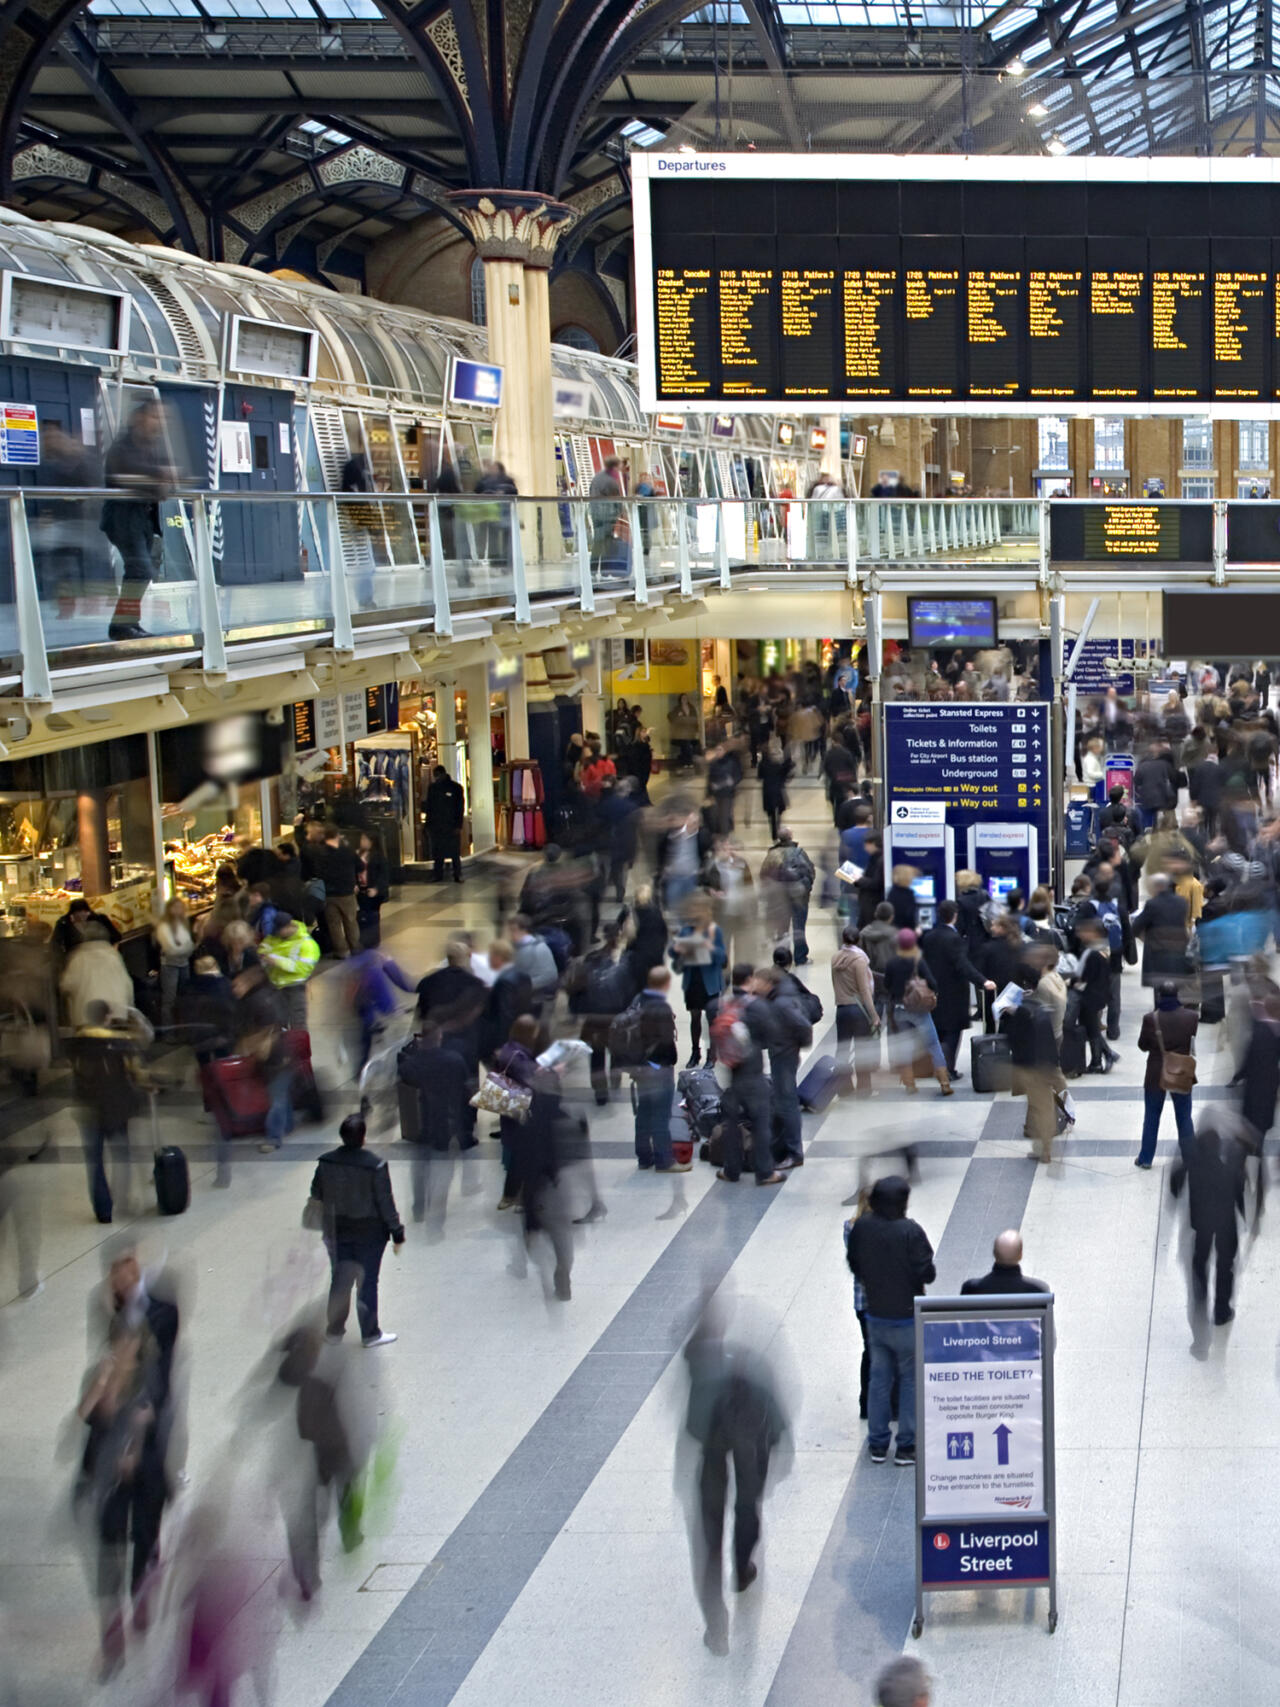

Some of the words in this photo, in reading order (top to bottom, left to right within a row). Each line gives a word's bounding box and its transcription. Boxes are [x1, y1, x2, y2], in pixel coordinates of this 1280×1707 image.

[658, 160, 726, 172] Departures
[684, 270, 710, 278] Cancelled
[866, 271, 890, 279] Platform
[891, 271, 896, 279] 2
[1172, 273, 1197, 281] Platform
[940, 709, 972, 717] Stansted
[975, 709, 1003, 718] Express
[969, 724, 997, 733] Toilets
[906, 739, 937, 748] Tickets
[939, 739, 946, 748] &
[950, 754, 966, 762] Bus
[942, 769, 998, 779] Underground
[960, 784, 980, 793] Way
[960, 799, 980, 808] Way
[943, 1336, 990, 1347] Liverpool
[993, 1335, 1022, 1345] Street
[929, 1372, 959, 1381] NEED
[963, 1371, 985, 1381] THE
[988, 1370, 1033, 1380] TOILET?
[946, 1412, 973, 1421] opposite
[976, 1412, 997, 1420] Burger
[930, 1475, 957, 1483] Change
[1007, 1471, 1033, 1479] situated
[928, 1484, 936, 1492] by
[960, 1530, 1038, 1550] Liverpool
[960, 1556, 1013, 1572] Street
